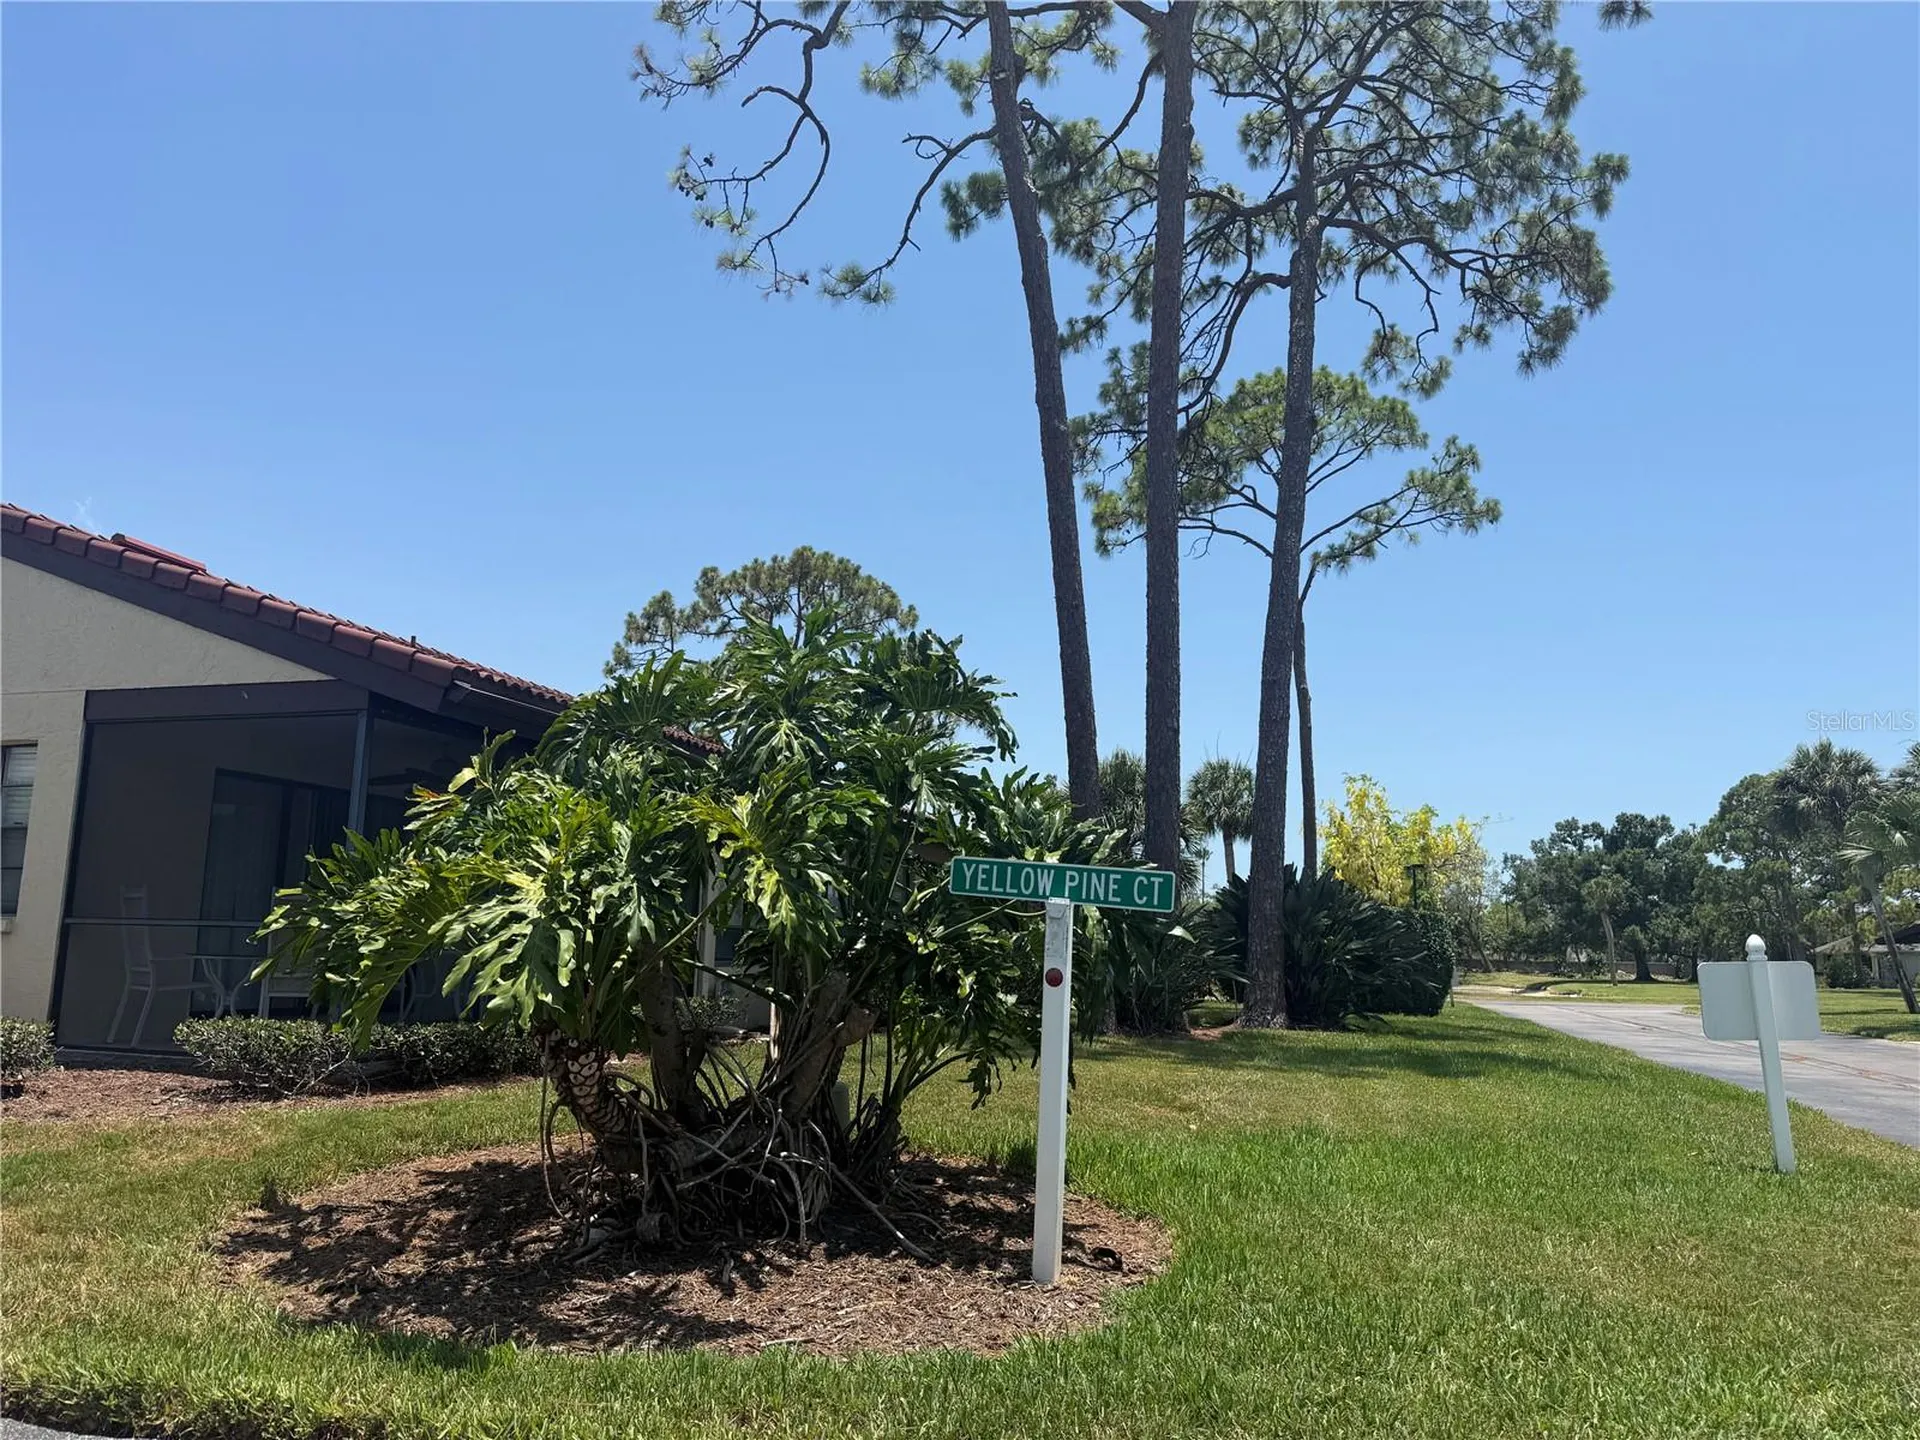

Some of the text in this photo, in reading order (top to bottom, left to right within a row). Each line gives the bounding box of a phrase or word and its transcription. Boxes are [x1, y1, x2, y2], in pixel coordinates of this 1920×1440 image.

[962, 862, 1164, 906] YELLOW PINE CT
